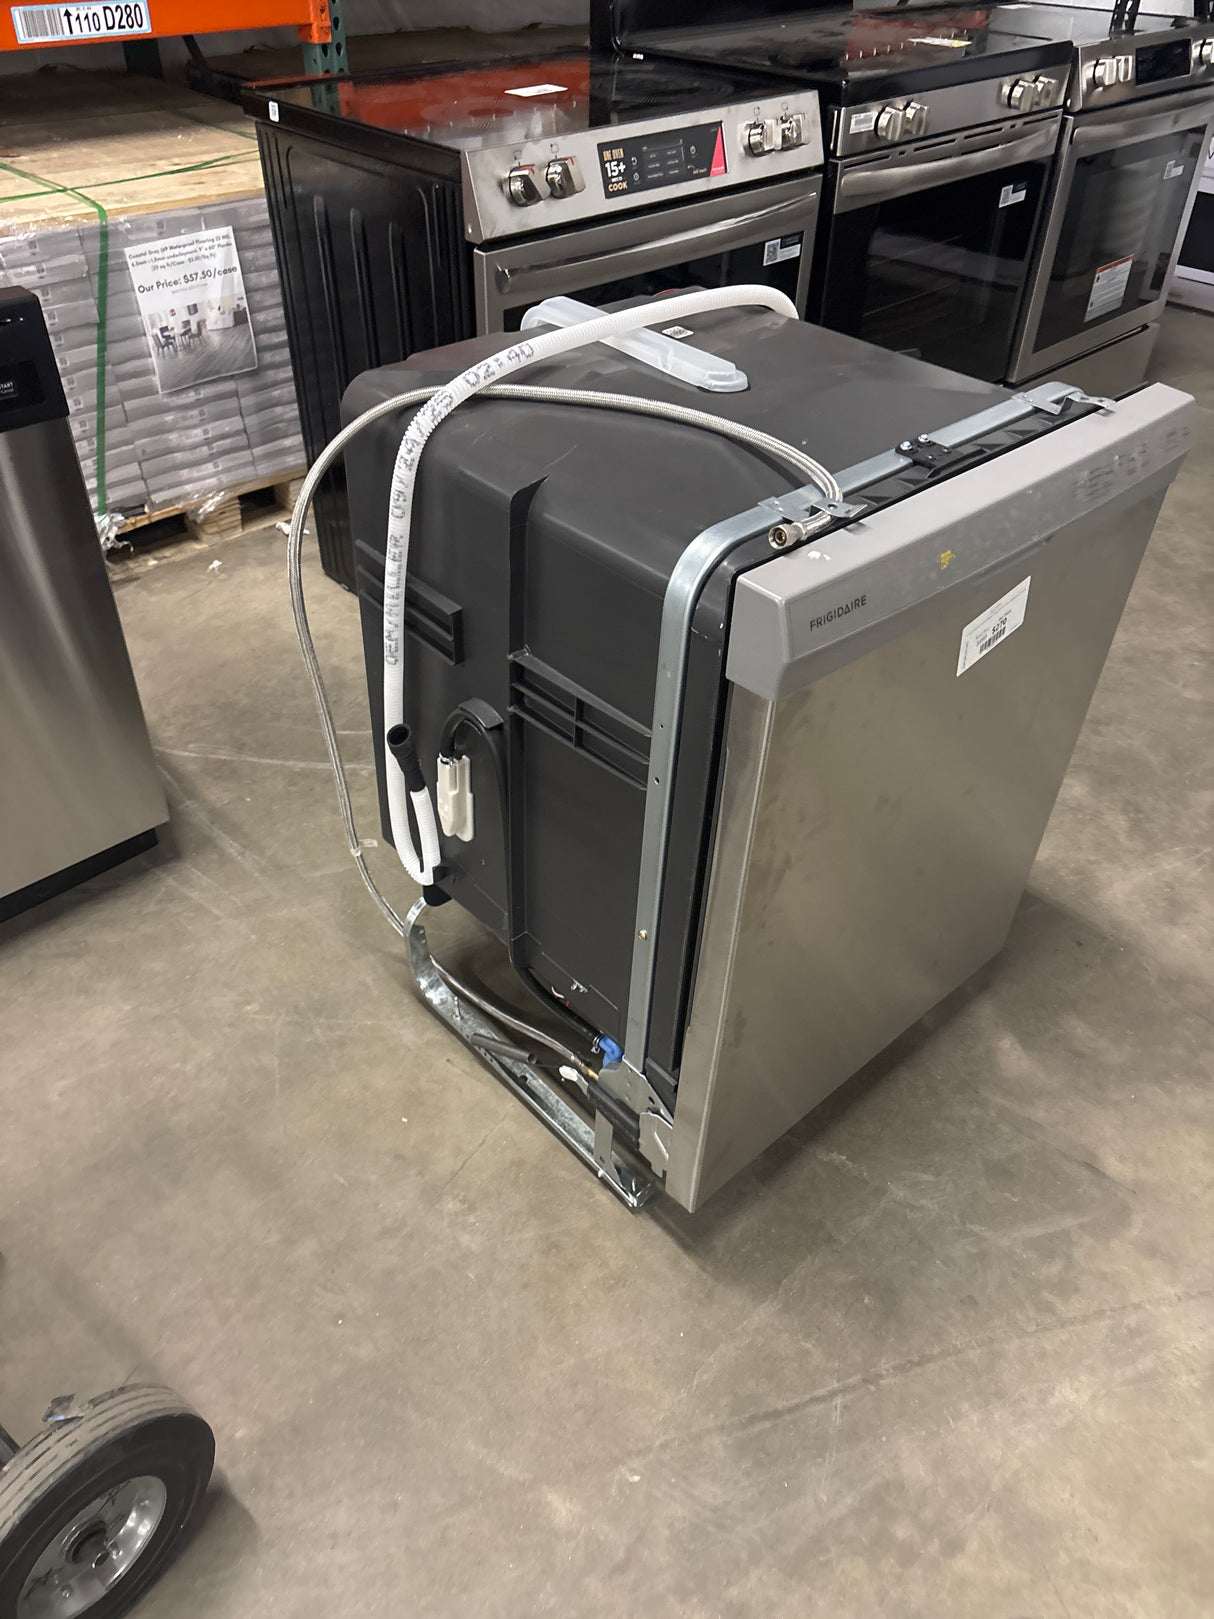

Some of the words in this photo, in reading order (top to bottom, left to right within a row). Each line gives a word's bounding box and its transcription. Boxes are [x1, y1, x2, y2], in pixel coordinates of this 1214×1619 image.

[75, 12, 101, 33] 110
[102, 3, 144, 31] D280
[604, 160, 626, 178] 15+
[608, 181, 628, 192] COOK
[169, 240, 194, 249] Waterproof
[138, 285, 154, 294] Our
[156, 279, 182, 290] Price:
[183, 266, 238, 284] $57.50/case
[809, 594, 867, 632] FRIGIDAIRE
